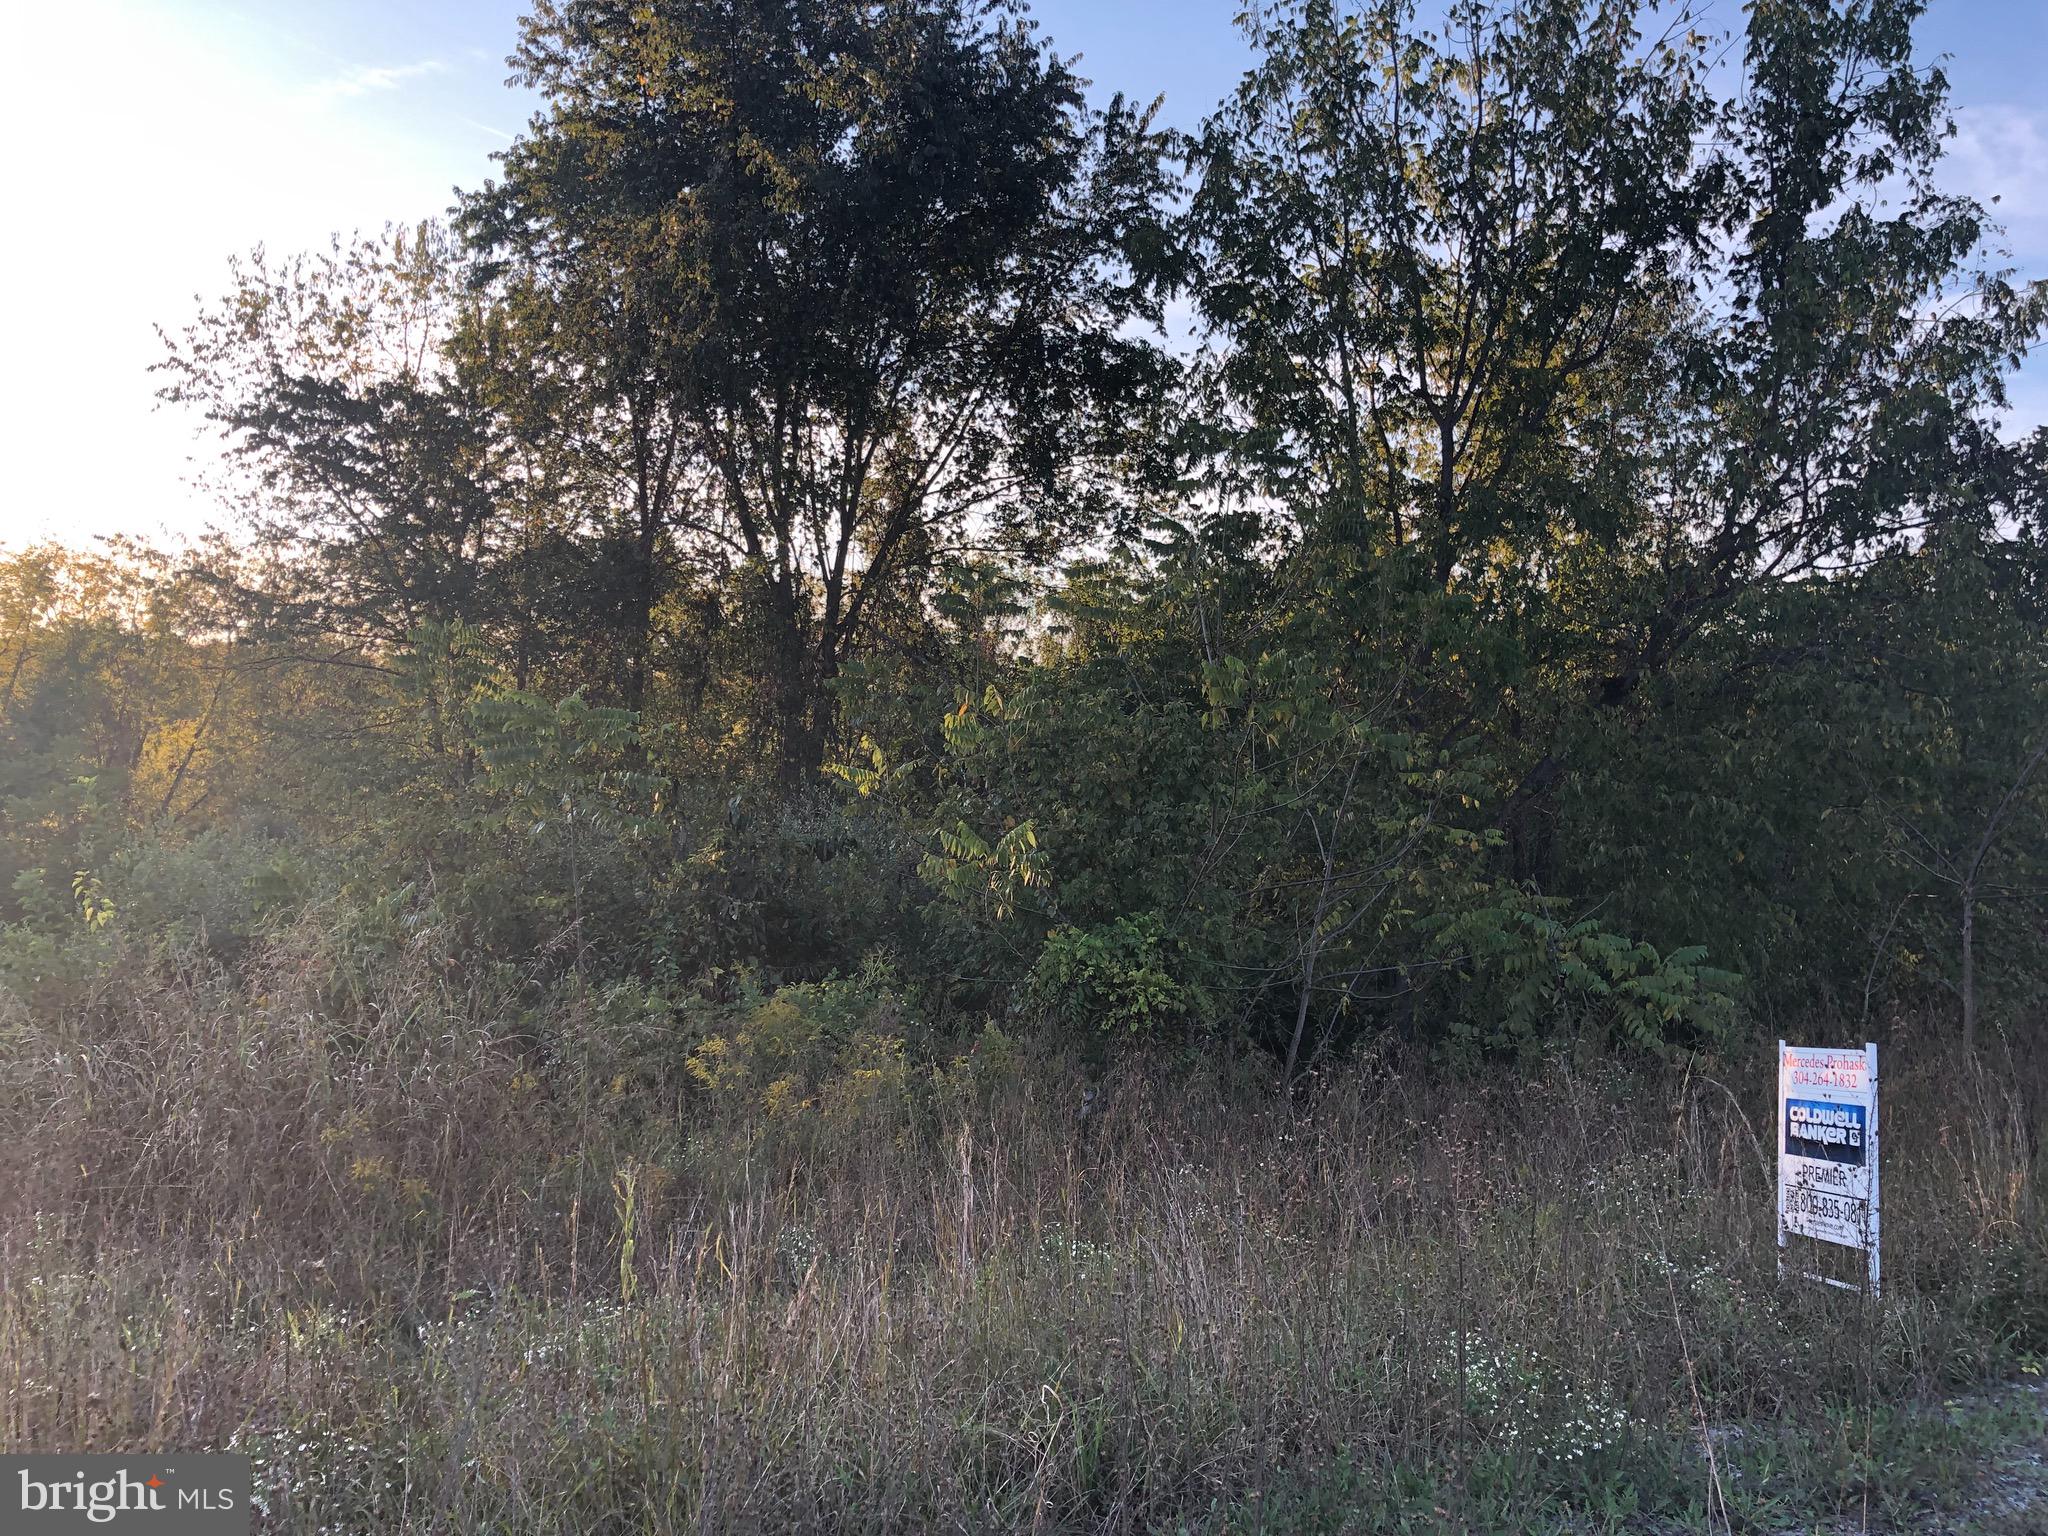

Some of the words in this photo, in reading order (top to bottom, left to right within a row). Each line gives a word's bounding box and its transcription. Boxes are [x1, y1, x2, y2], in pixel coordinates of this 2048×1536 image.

[1783, 1052, 1824, 1069] Mercedes
[1793, 1070, 1858, 1089] 304-264-1832
[1789, 1105, 1862, 1129] COLDWELL
[1790, 1121, 1847, 1146] BANKER
[1802, 1164, 1848, 1187] PREMIER
